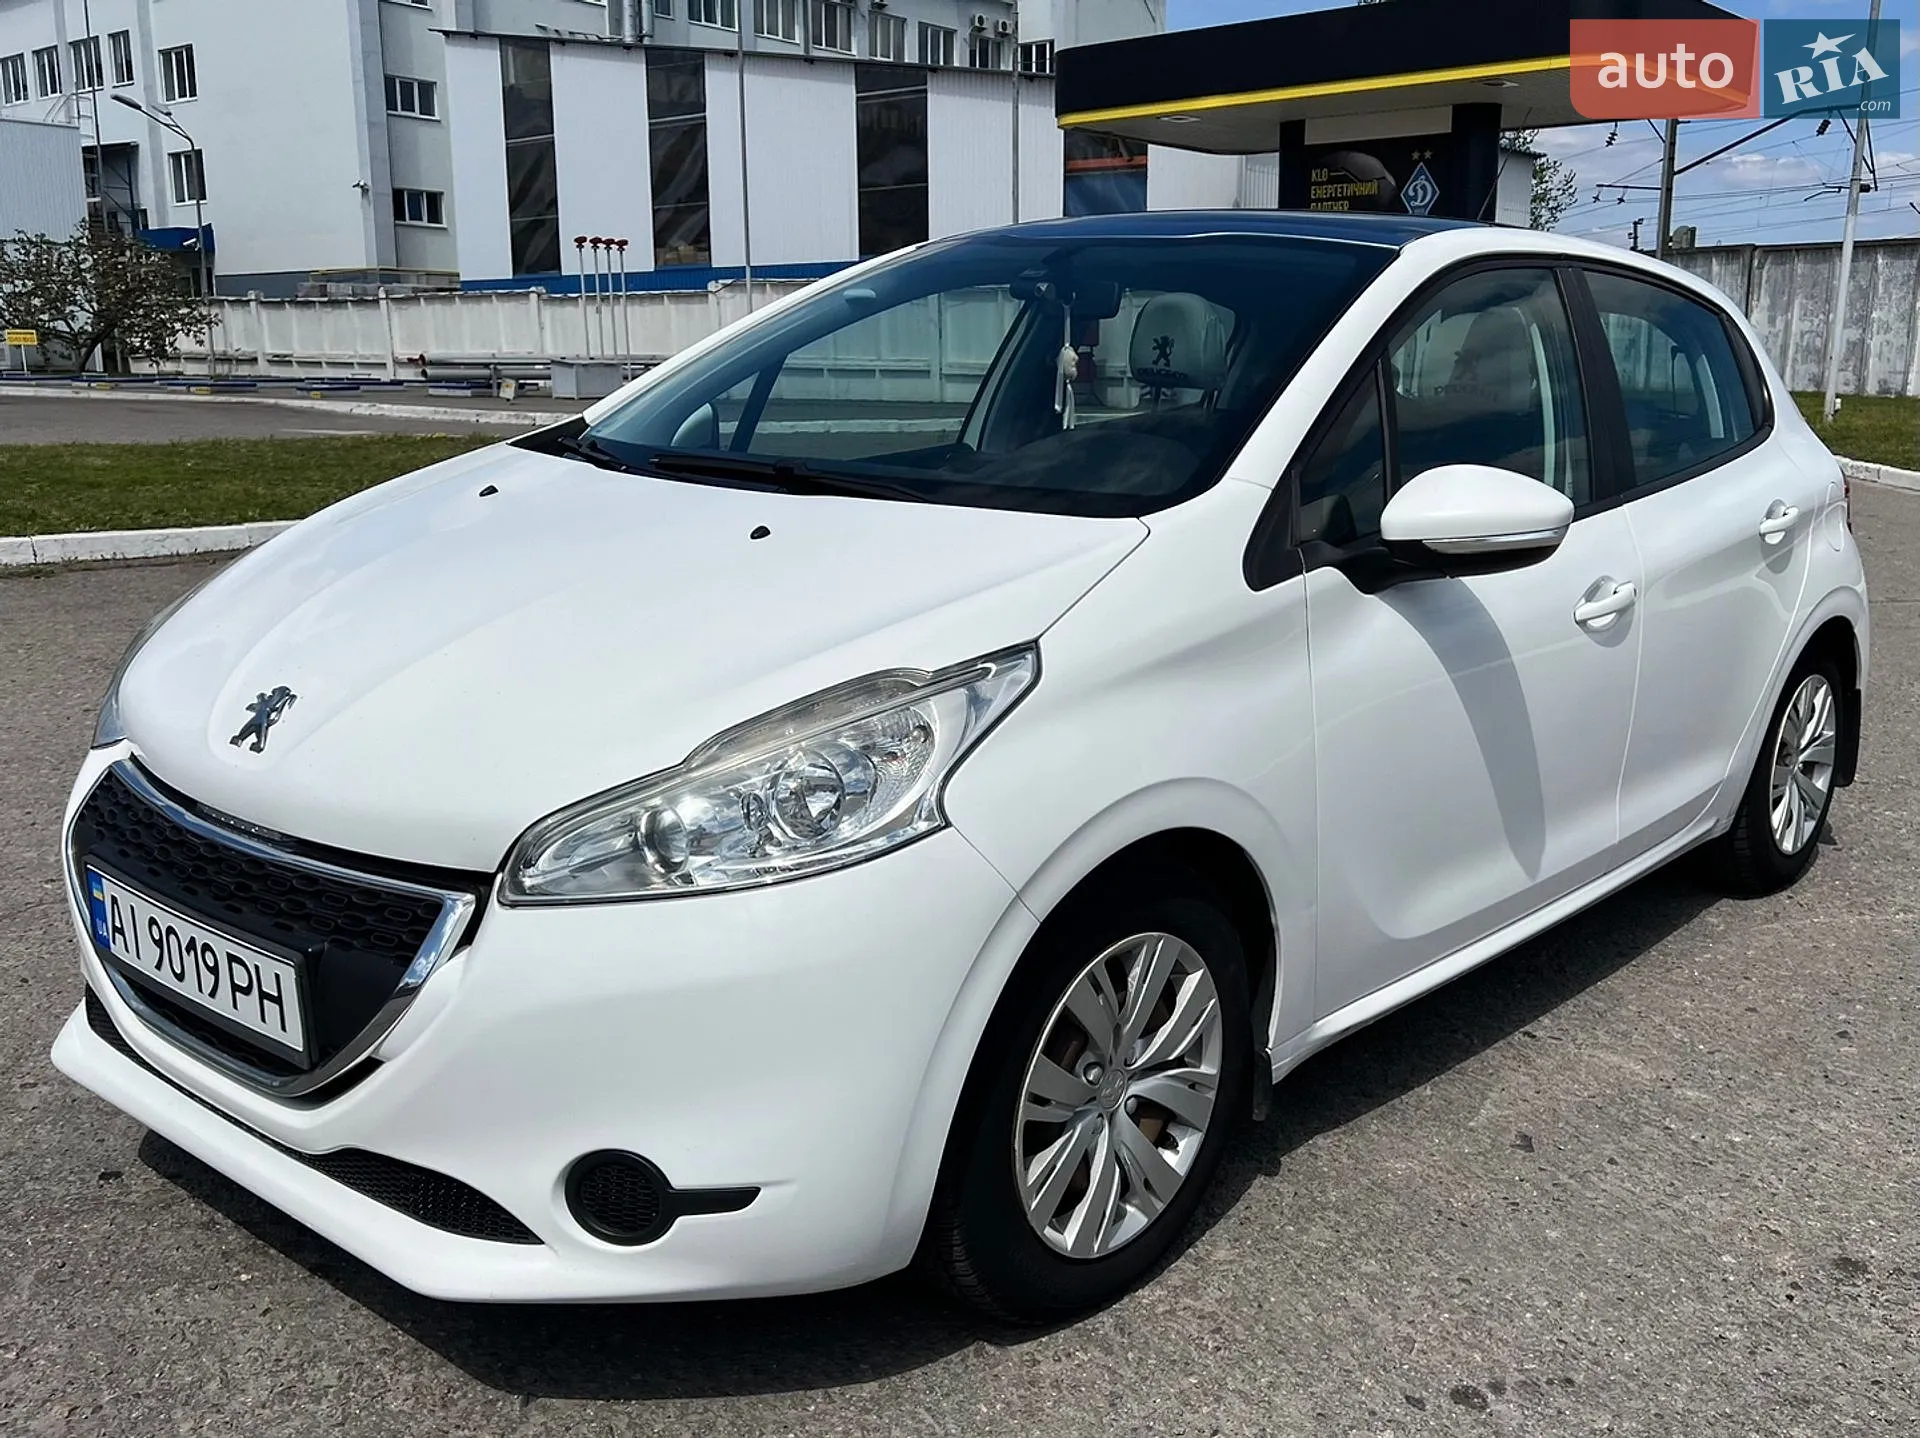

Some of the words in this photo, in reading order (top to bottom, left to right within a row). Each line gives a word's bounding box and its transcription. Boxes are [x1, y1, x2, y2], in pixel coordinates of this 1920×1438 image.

[1310, 180, 1379, 199] ЕНЕРГЕТИЧНИЙ
[110, 893, 142, 960] AI
[147, 916, 220, 999] 9019
[225, 950, 288, 1033] PH
